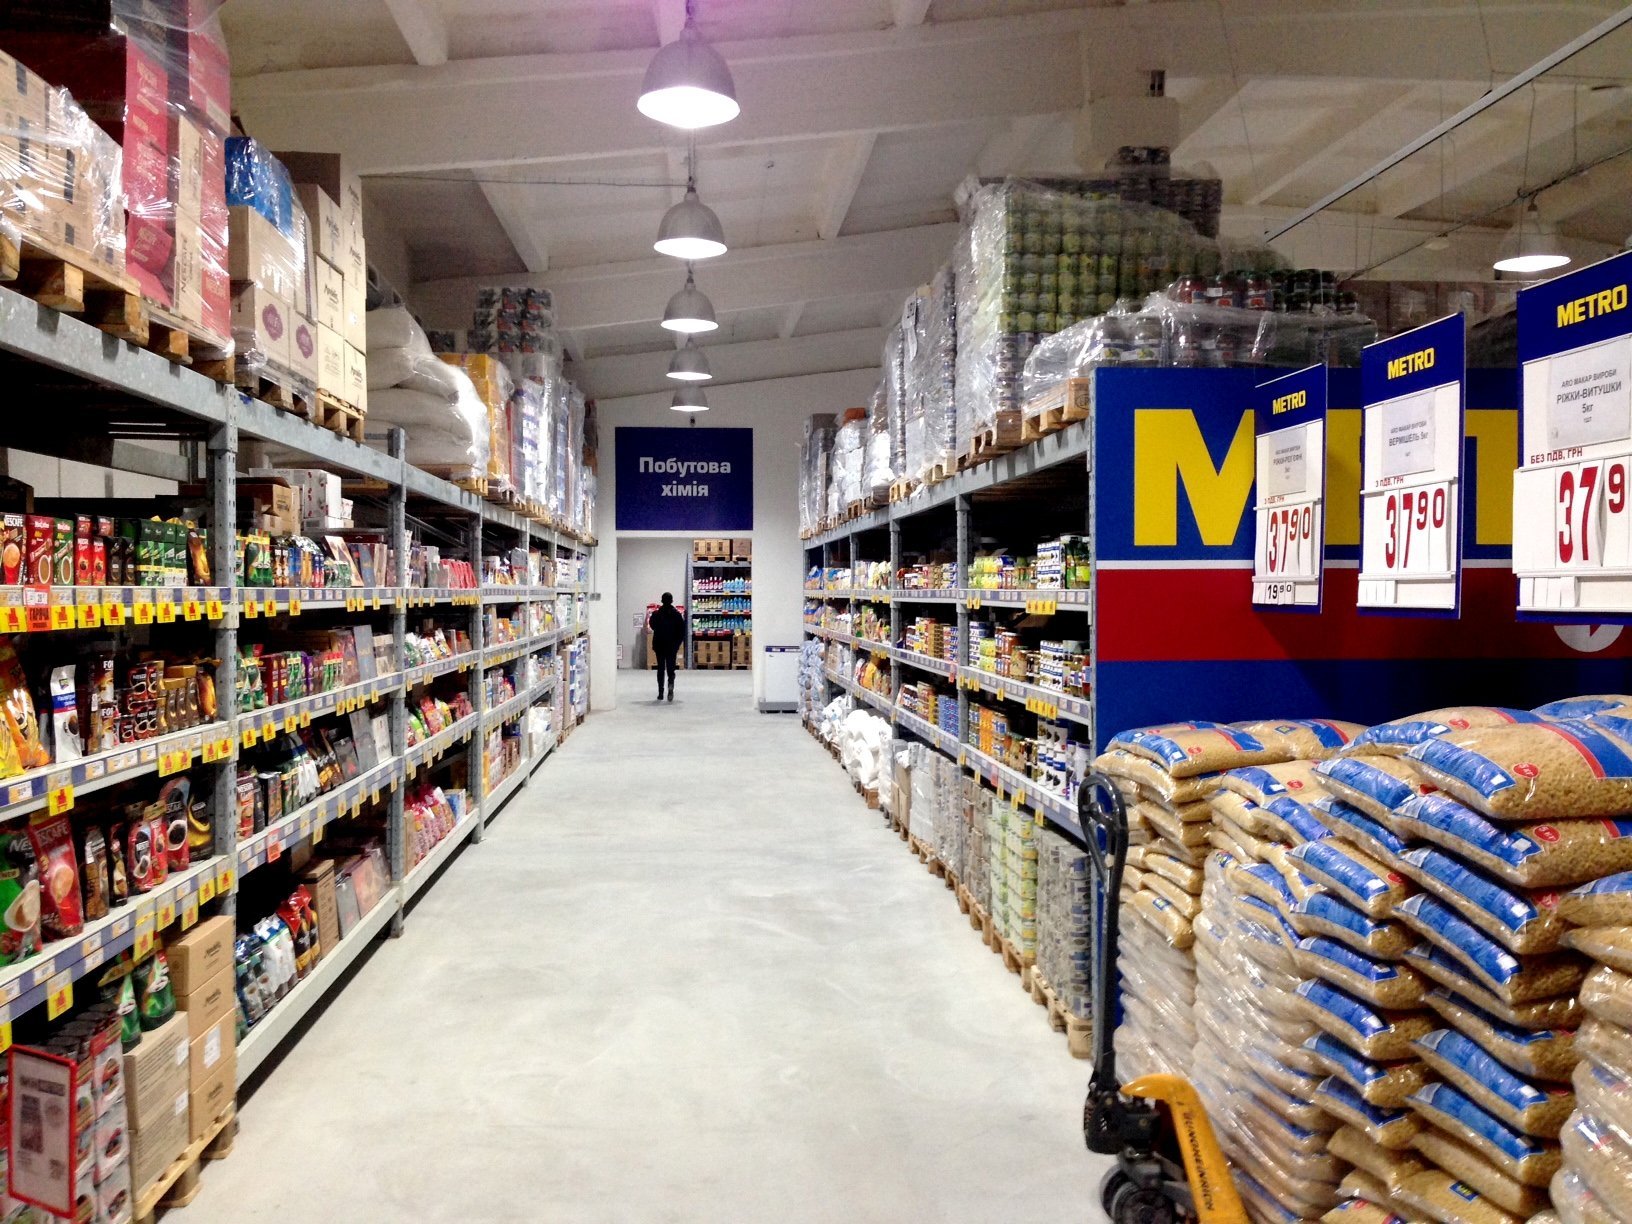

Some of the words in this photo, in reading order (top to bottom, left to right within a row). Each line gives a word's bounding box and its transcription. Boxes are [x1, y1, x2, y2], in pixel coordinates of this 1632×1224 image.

[1556, 284, 1628, 328] METRO
[1387, 347, 1435, 380] METRO
[1272, 390, 1306, 415] METRO
[1556, 381, 1622, 404] РІЖКИ-ВИТУШКИ
[639, 456, 731, 478] Побутова
[1530, 454, 1545, 464] БЕЗ
[1546, 450, 1566, 462] ПДВ,
[1567, 447, 1583, 459] ГРН
[661, 480, 709, 497] хімія
